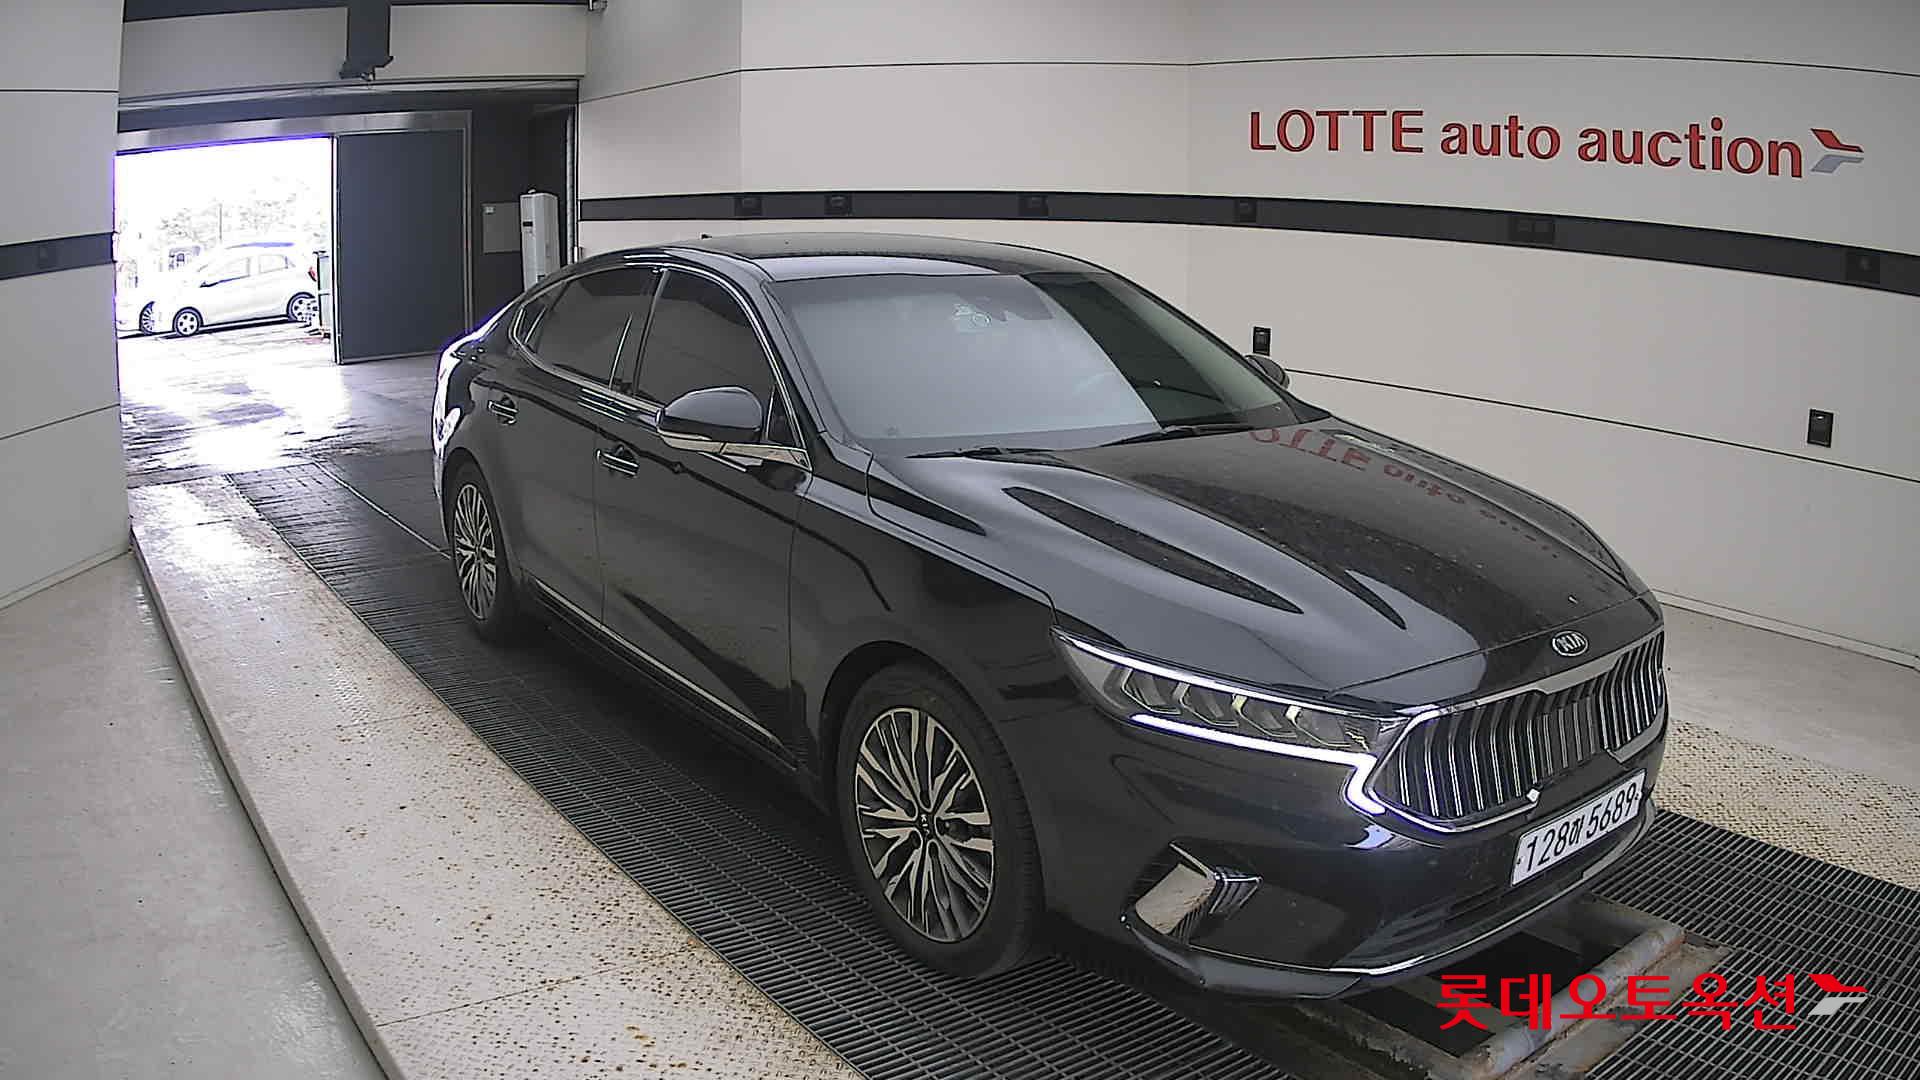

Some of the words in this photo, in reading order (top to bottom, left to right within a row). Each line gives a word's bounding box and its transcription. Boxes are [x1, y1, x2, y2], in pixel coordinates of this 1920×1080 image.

[1249, 110, 1424, 153] LOTTE
[1440, 115, 1561, 159] auto
[1577, 116, 1803, 178] auction
[1556, 633, 1585, 652] KIA
[1585, 782, 1638, 839] 5689
